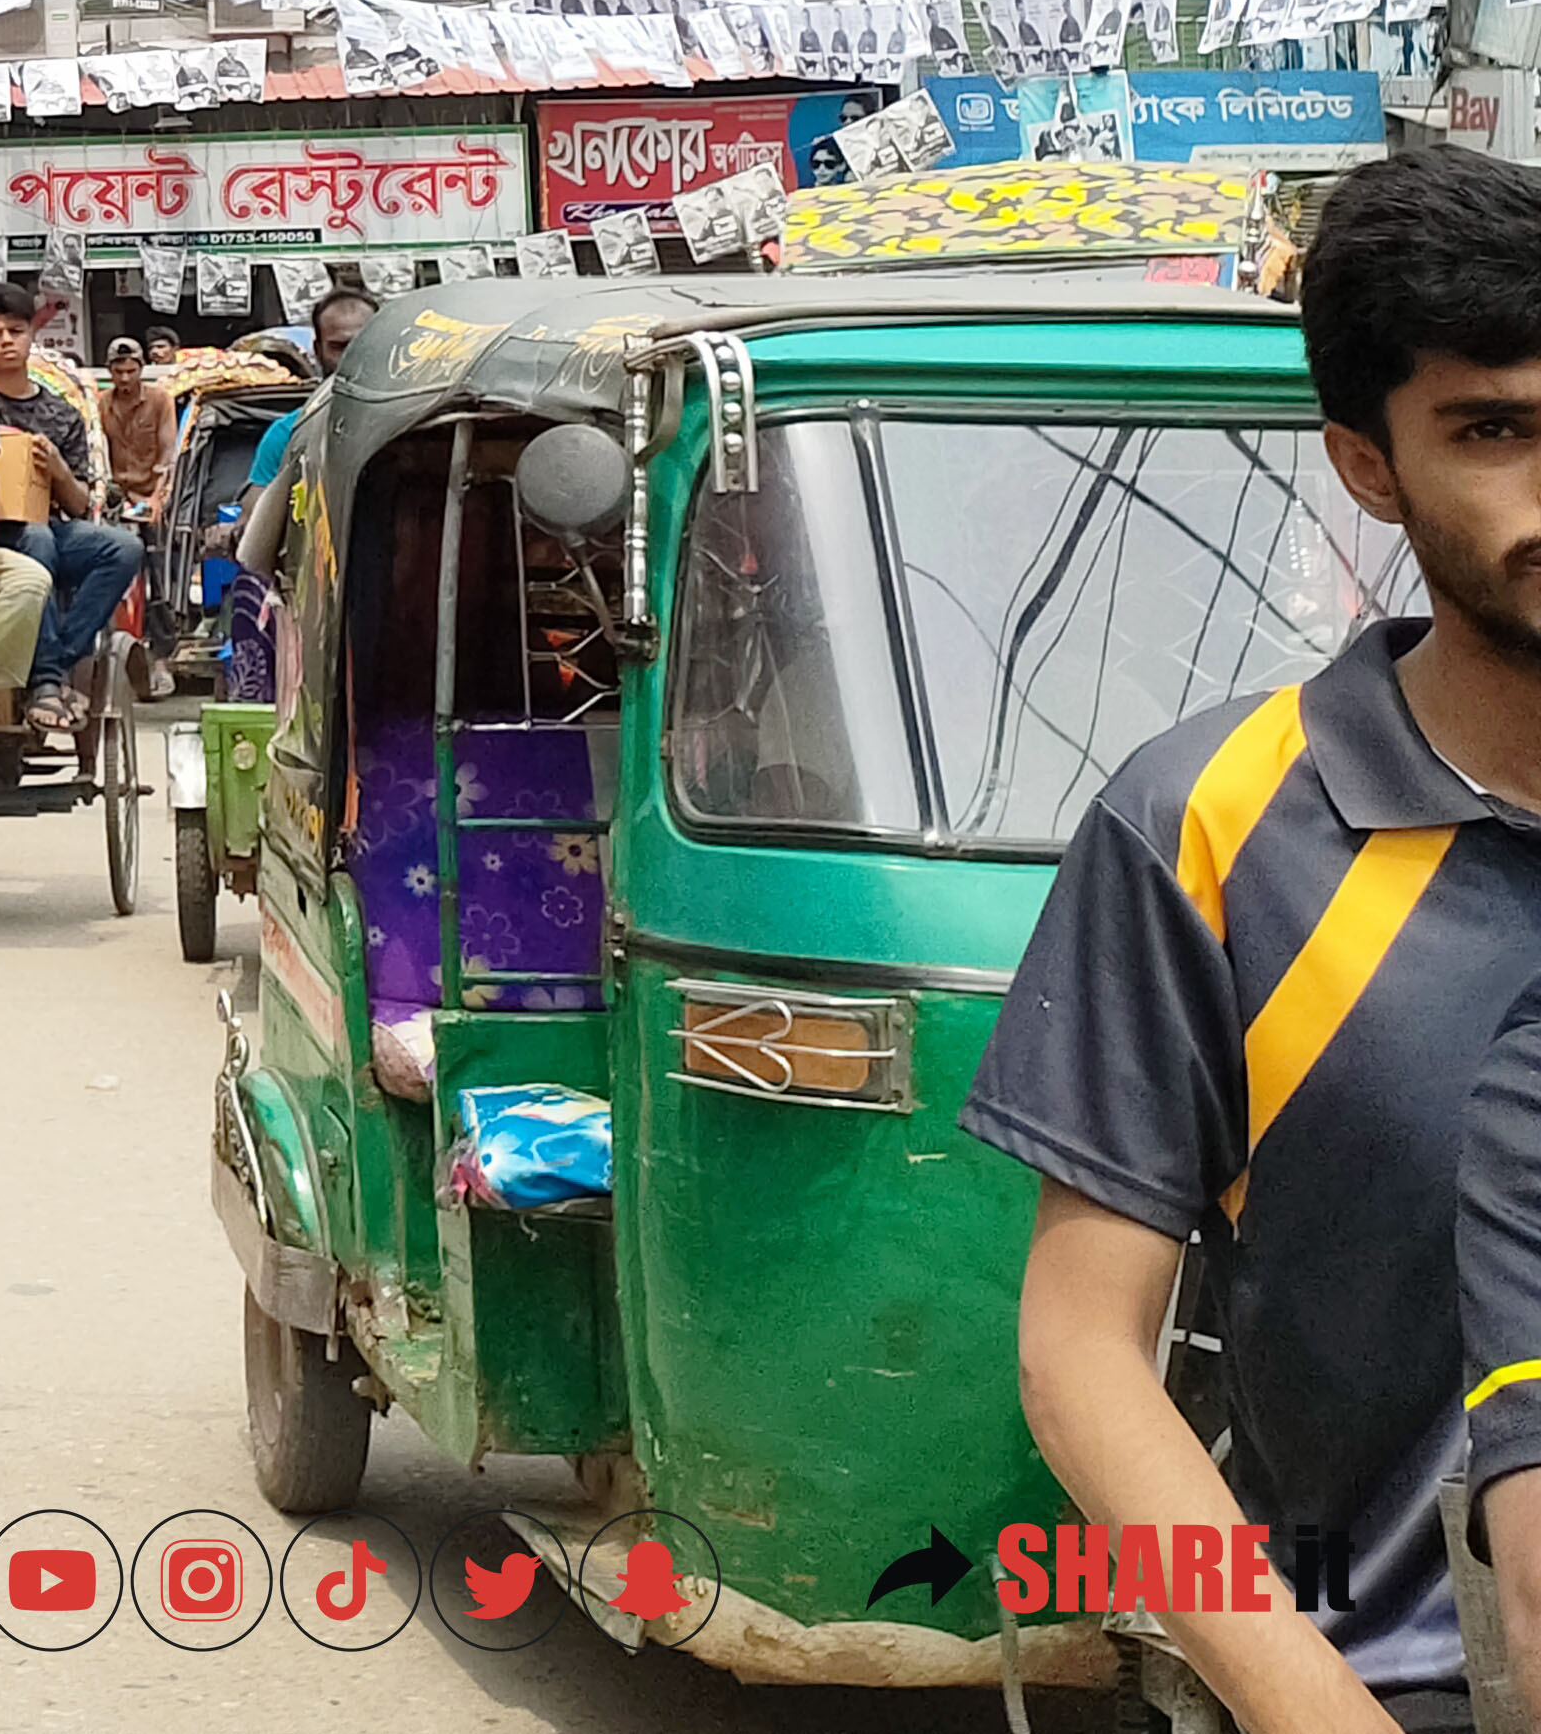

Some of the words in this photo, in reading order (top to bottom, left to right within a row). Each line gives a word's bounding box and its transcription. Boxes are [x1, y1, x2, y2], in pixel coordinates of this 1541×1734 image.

[1217, 87, 1354, 124] লিমিটেড
[1450, 86, 1501, 147] Bay
[8, 145, 213, 227] পয়েন্ট
